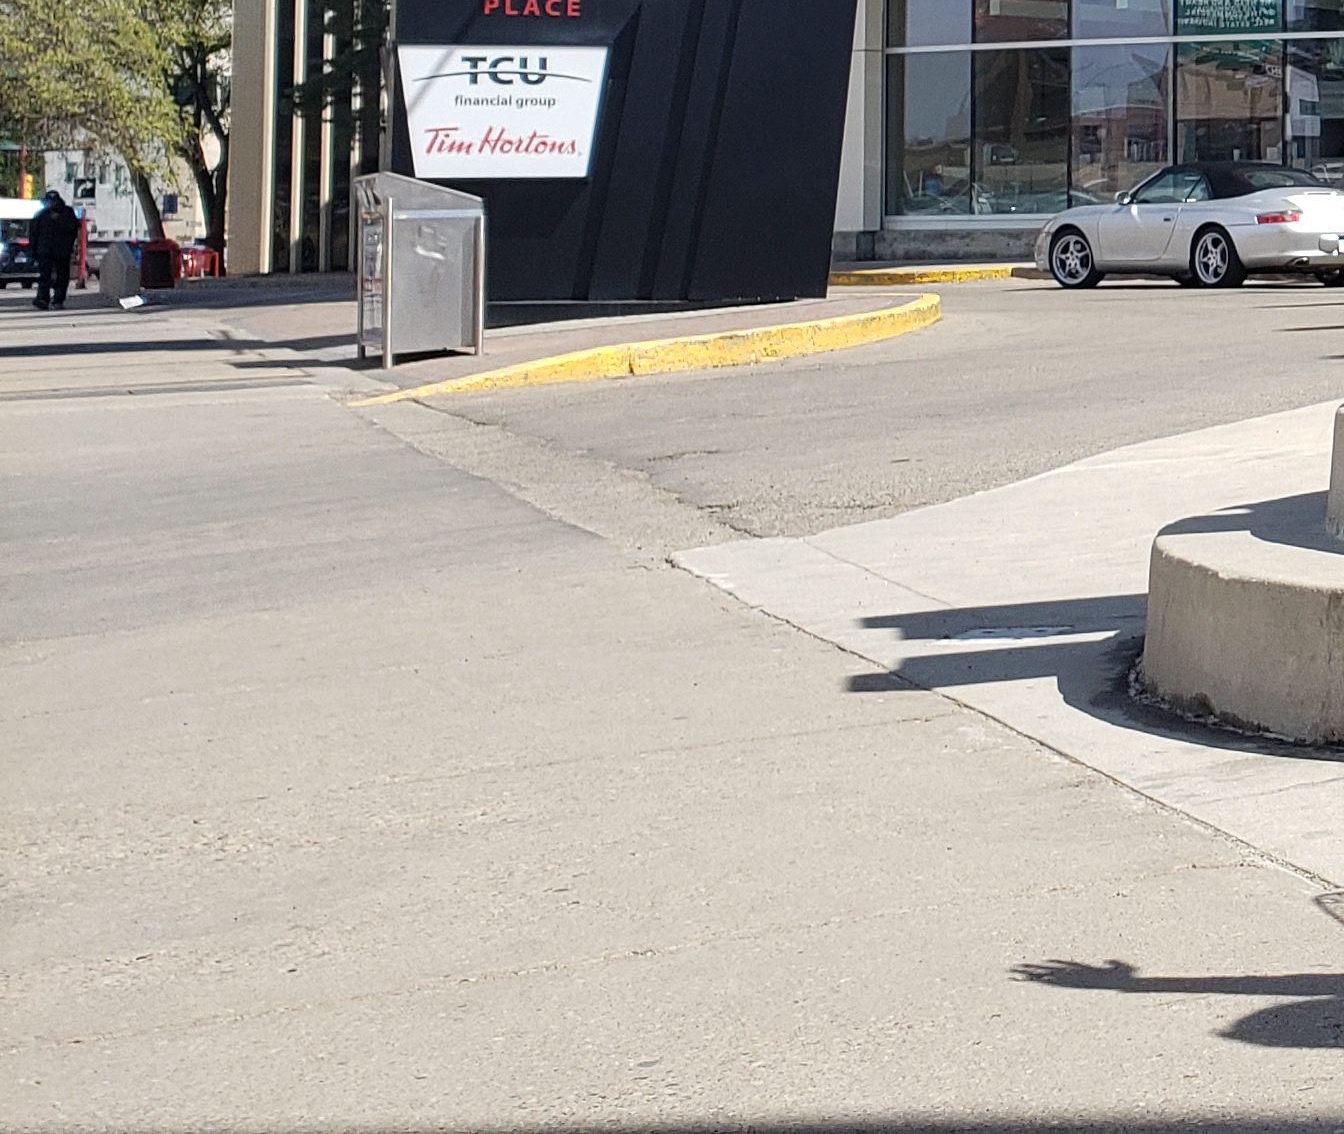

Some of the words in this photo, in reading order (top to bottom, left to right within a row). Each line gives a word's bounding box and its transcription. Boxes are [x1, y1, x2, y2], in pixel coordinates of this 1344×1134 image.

[461, 56, 547, 85] TCU
[454, 95, 512, 107] financial
[515, 97, 556, 109] group
[424, 126, 473, 155] Tim
[478, 125, 577, 155] Hortons
